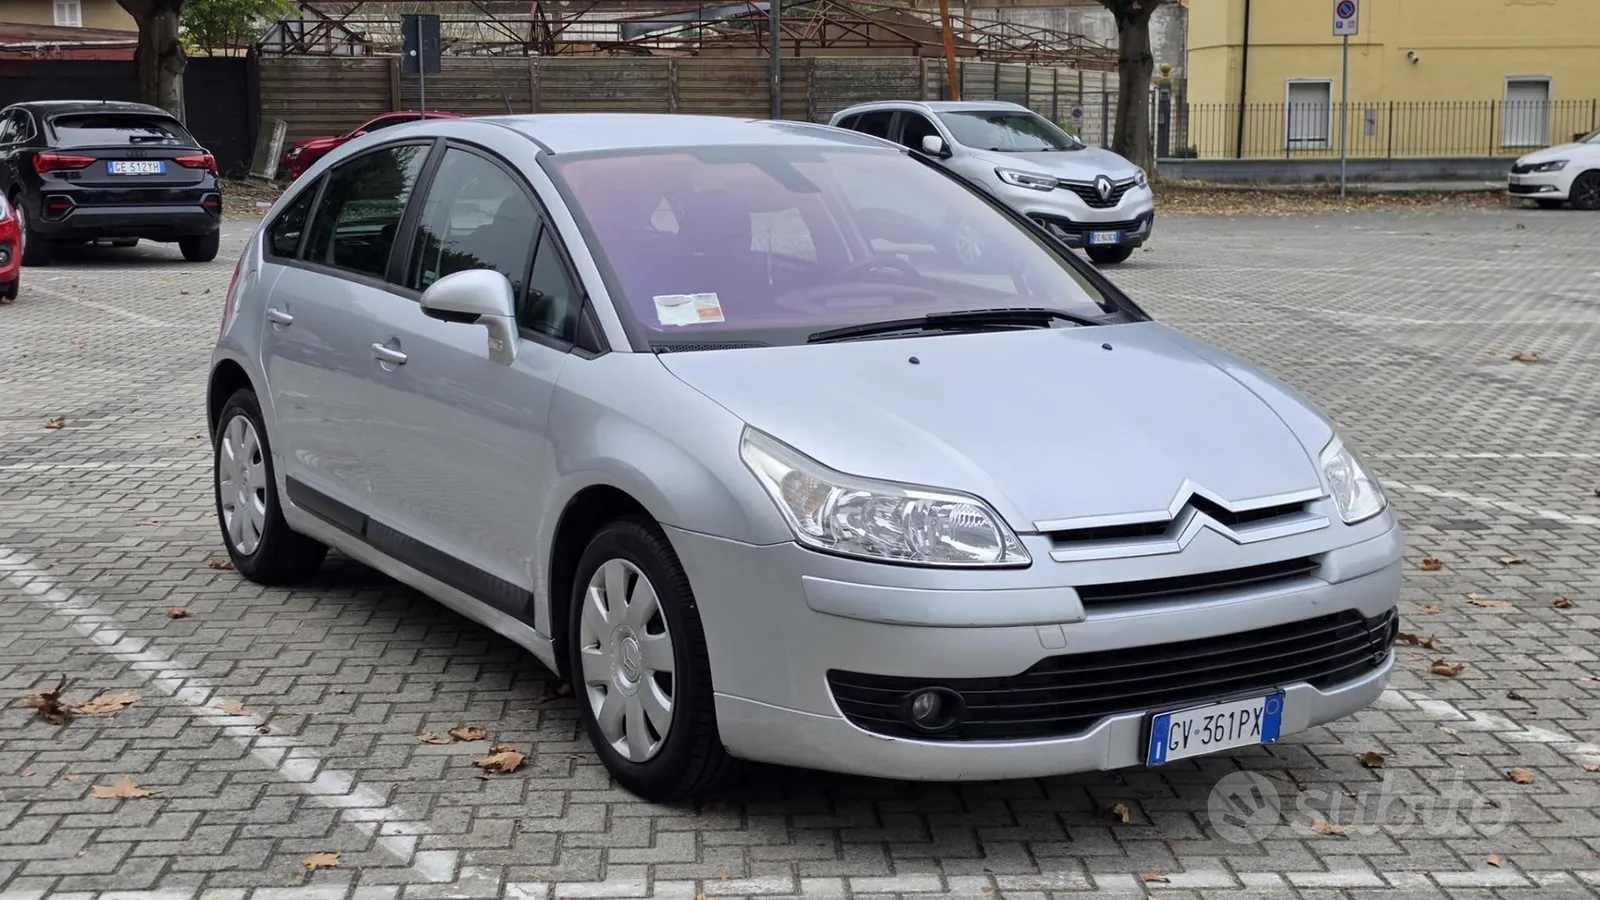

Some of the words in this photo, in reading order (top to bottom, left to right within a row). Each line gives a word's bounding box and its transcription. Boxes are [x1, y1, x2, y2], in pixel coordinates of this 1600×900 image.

[130, 162, 159, 172] 512YH
[1168, 719, 1193, 751] GV
[1201, 706, 1263, 745] 361PX
